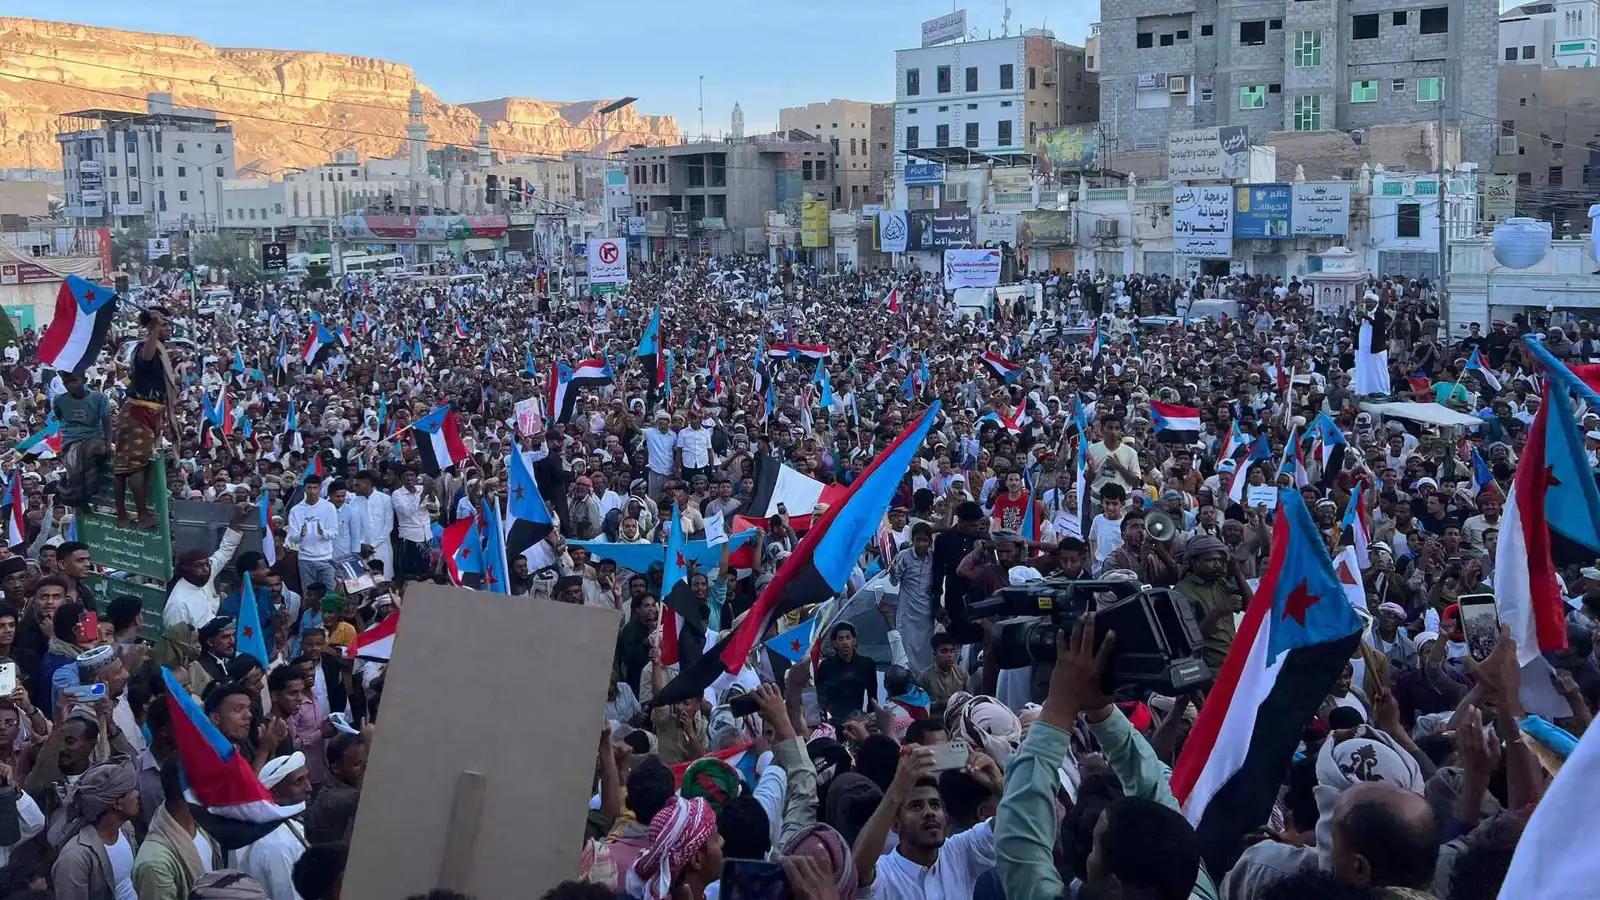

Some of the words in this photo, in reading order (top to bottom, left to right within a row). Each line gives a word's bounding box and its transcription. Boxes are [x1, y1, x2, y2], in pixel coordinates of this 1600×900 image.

[1204, 189, 1228, 205] برمجة
[1270, 190, 1288, 200] عالم
[1297, 194, 1328, 202] الصيانة
[1197, 205, 1228, 221] وصيانة
[1252, 203, 1288, 213] الجوالات
[1307, 215, 1333, 225] وبرمجة
[1175, 220, 1228, 236] الجوالات
[1295, 224, 1326, 233] الجوالات
